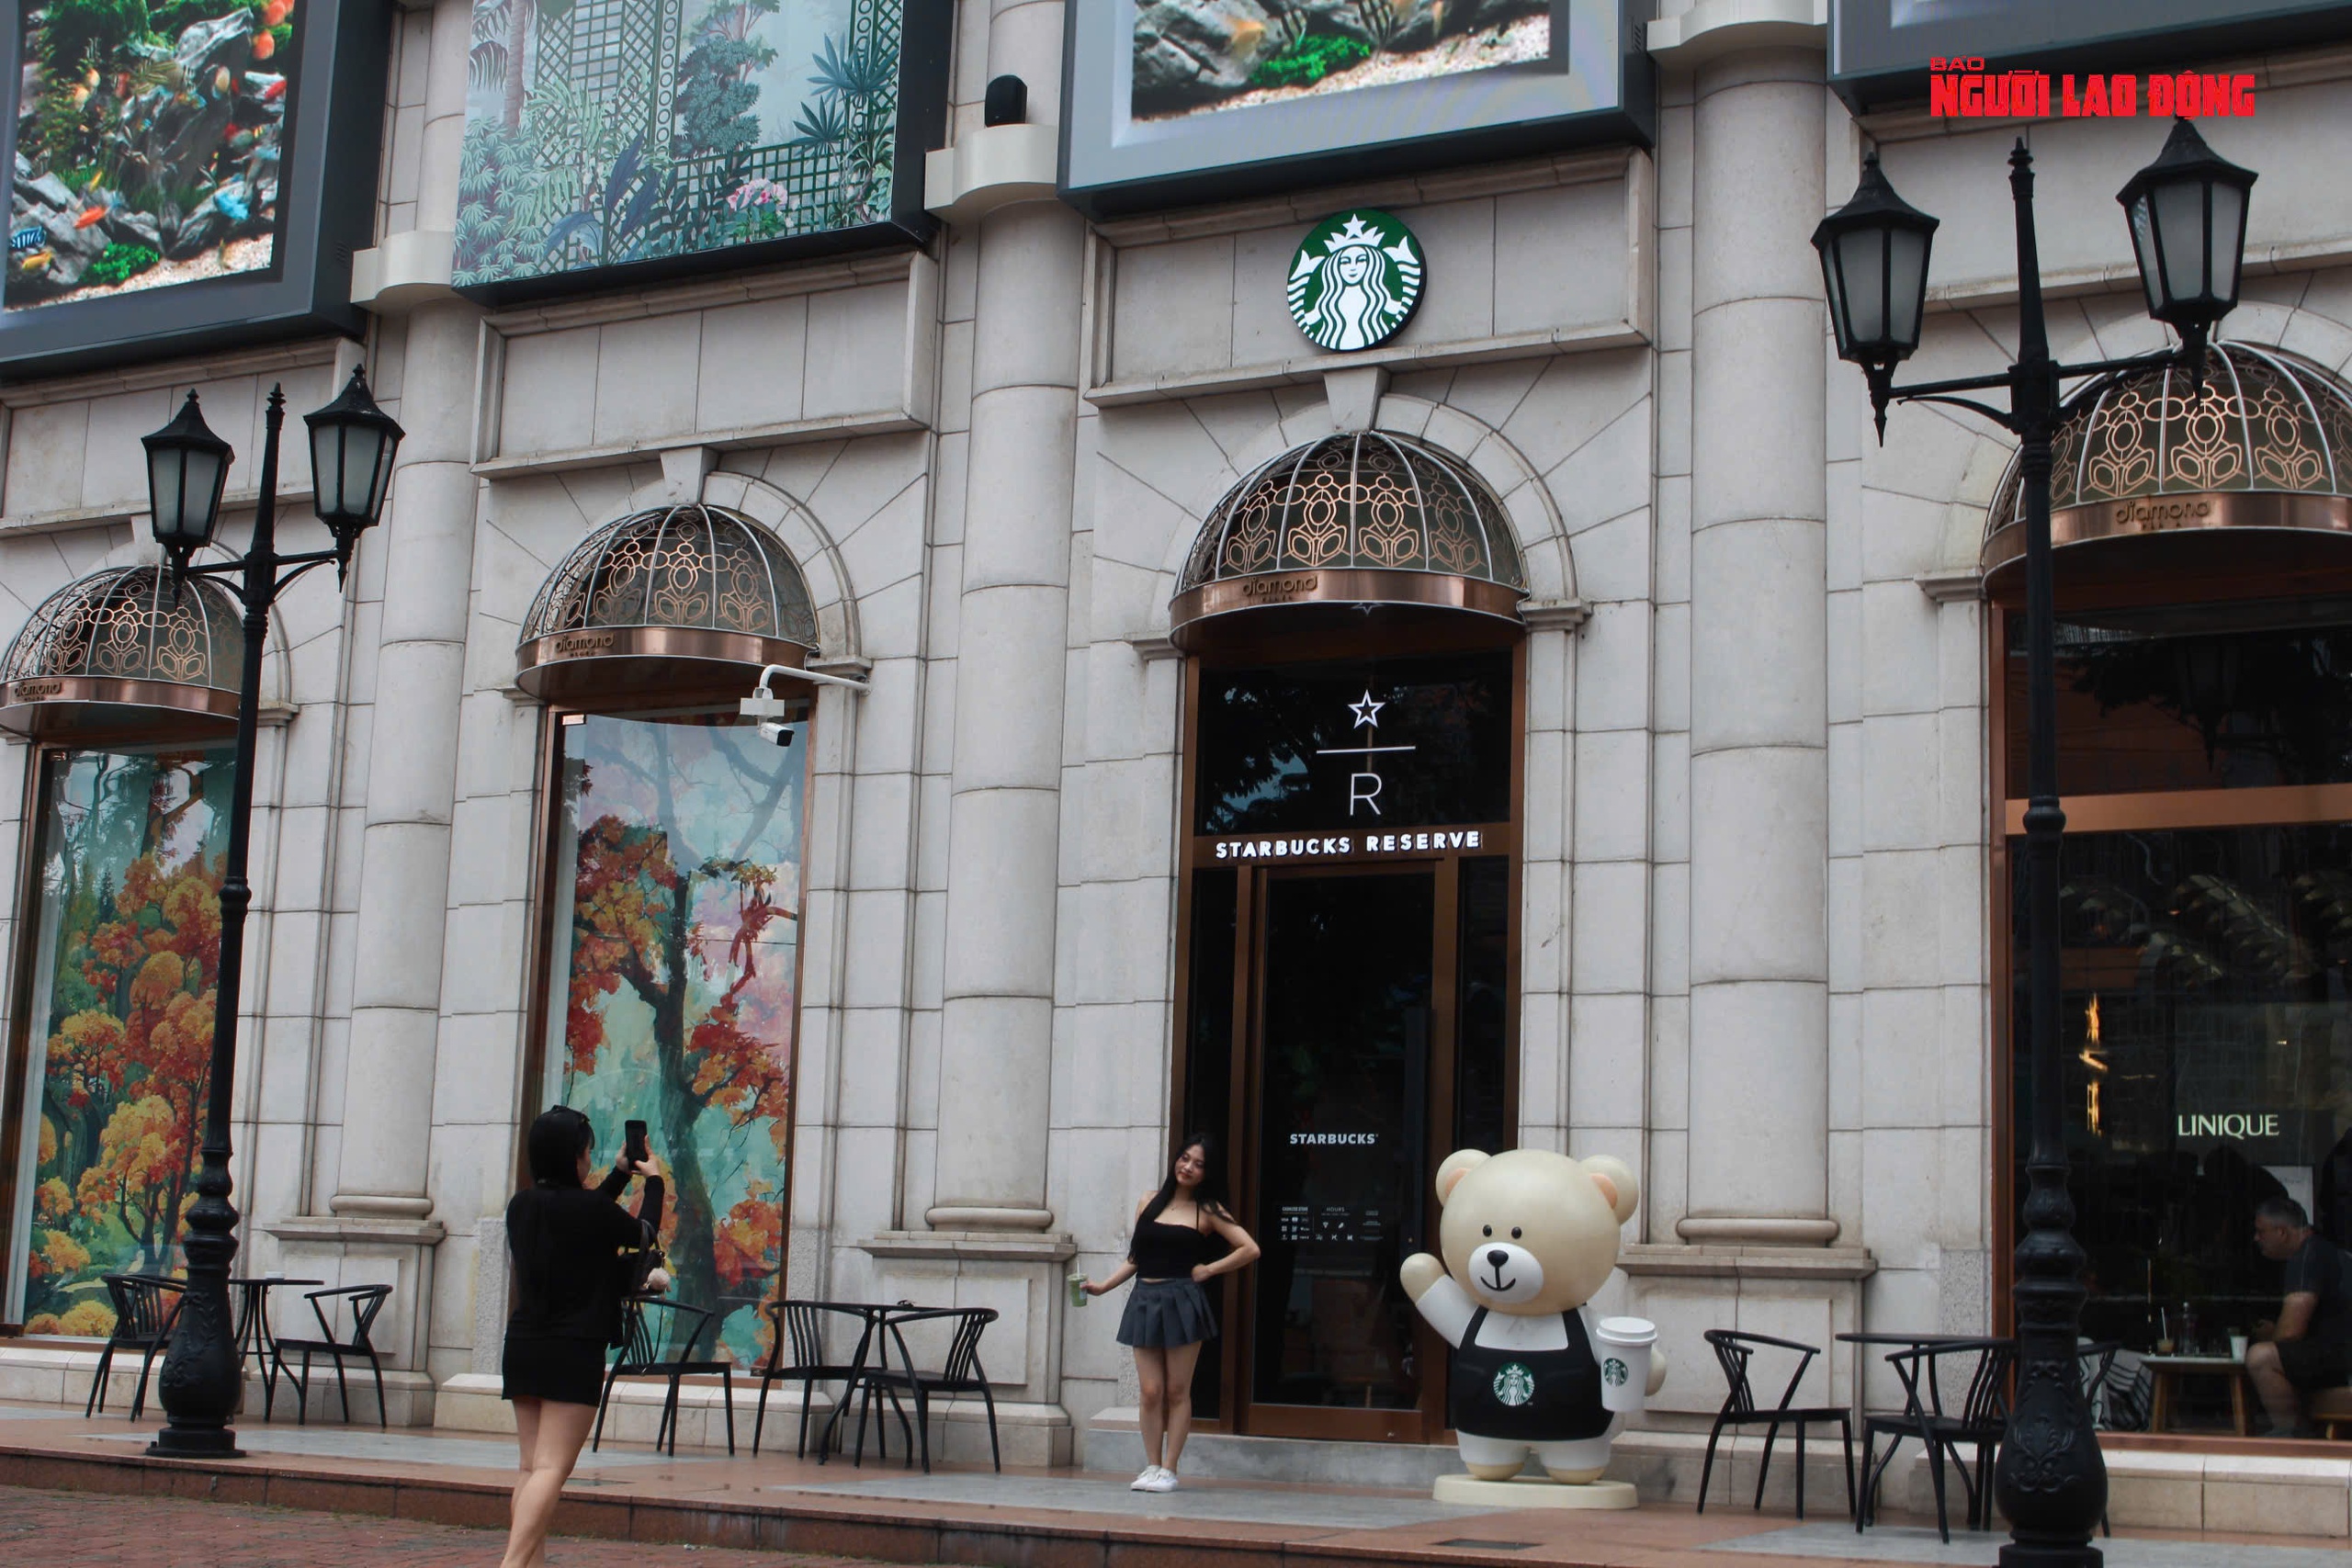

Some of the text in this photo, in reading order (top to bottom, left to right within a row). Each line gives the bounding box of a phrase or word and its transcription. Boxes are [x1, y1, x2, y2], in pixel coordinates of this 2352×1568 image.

[2116, 501, 2210, 525] diamond
[1243, 573, 1318, 597] diamond
[555, 632, 615, 653] diamond
[15, 682, 63, 697] diamond
[1350, 773, 1382, 816] R
[1216, 830, 1480, 859] STARBUCKS RESERVE
[2177, 1114, 2280, 1140] LINIQUE
[1290, 1134, 1376, 1145] STARBUCKS
